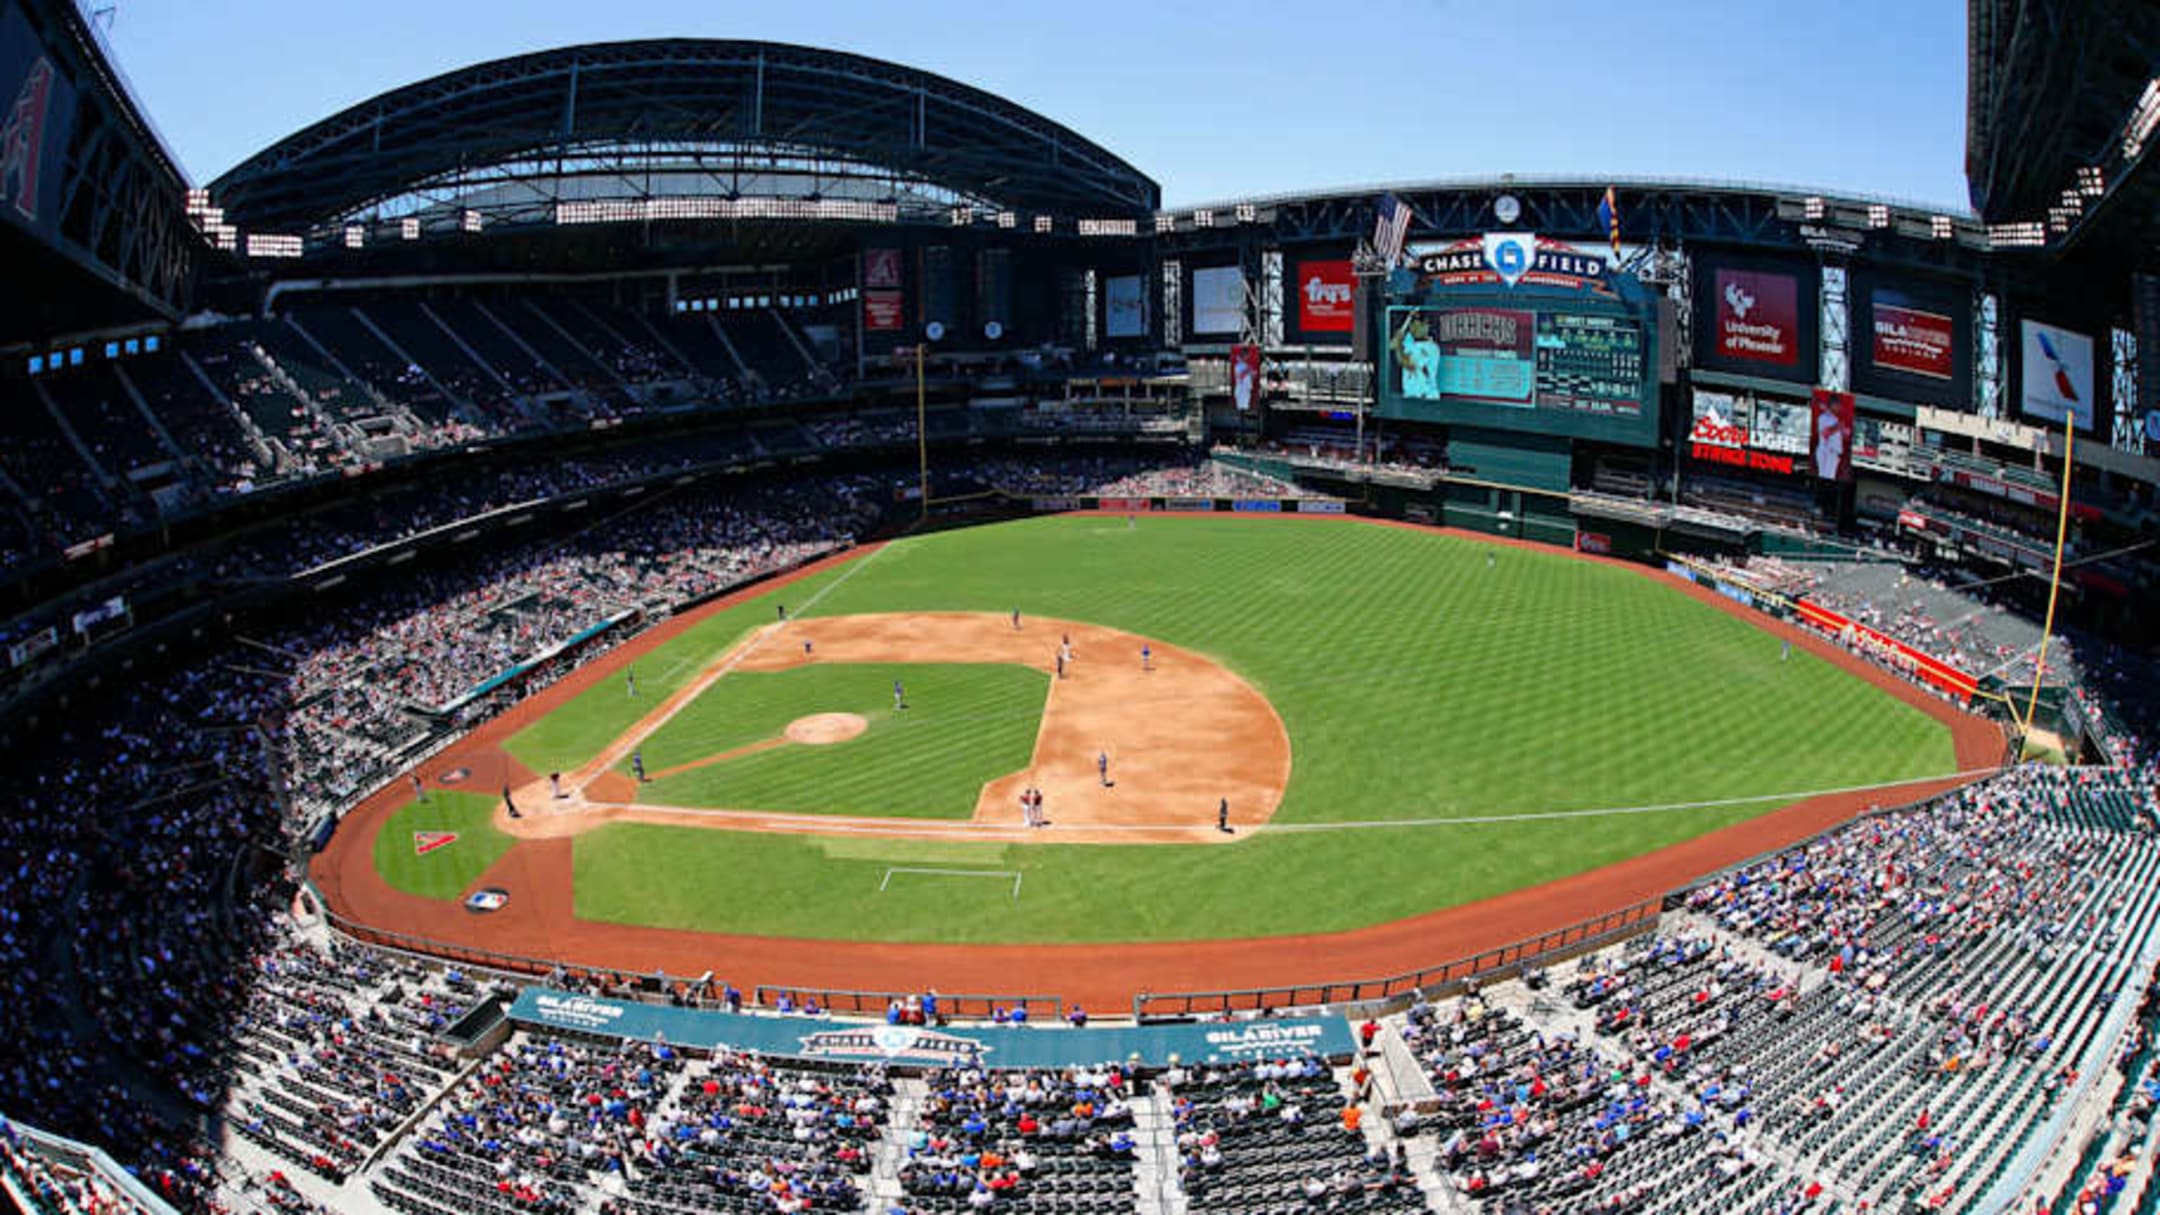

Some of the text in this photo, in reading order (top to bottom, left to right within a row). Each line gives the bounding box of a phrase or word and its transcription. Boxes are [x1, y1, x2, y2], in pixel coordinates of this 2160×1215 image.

[1424, 254, 1601, 275] CHASE FIELD
[1725, 321, 1781, 344] University
[1875, 321, 1907, 337] GILA
[1725, 334, 1783, 353] of Phoenix
[1694, 416, 1799, 454] Coors LIGHT
[1692, 443, 1793, 475] STRIKE ZONE
